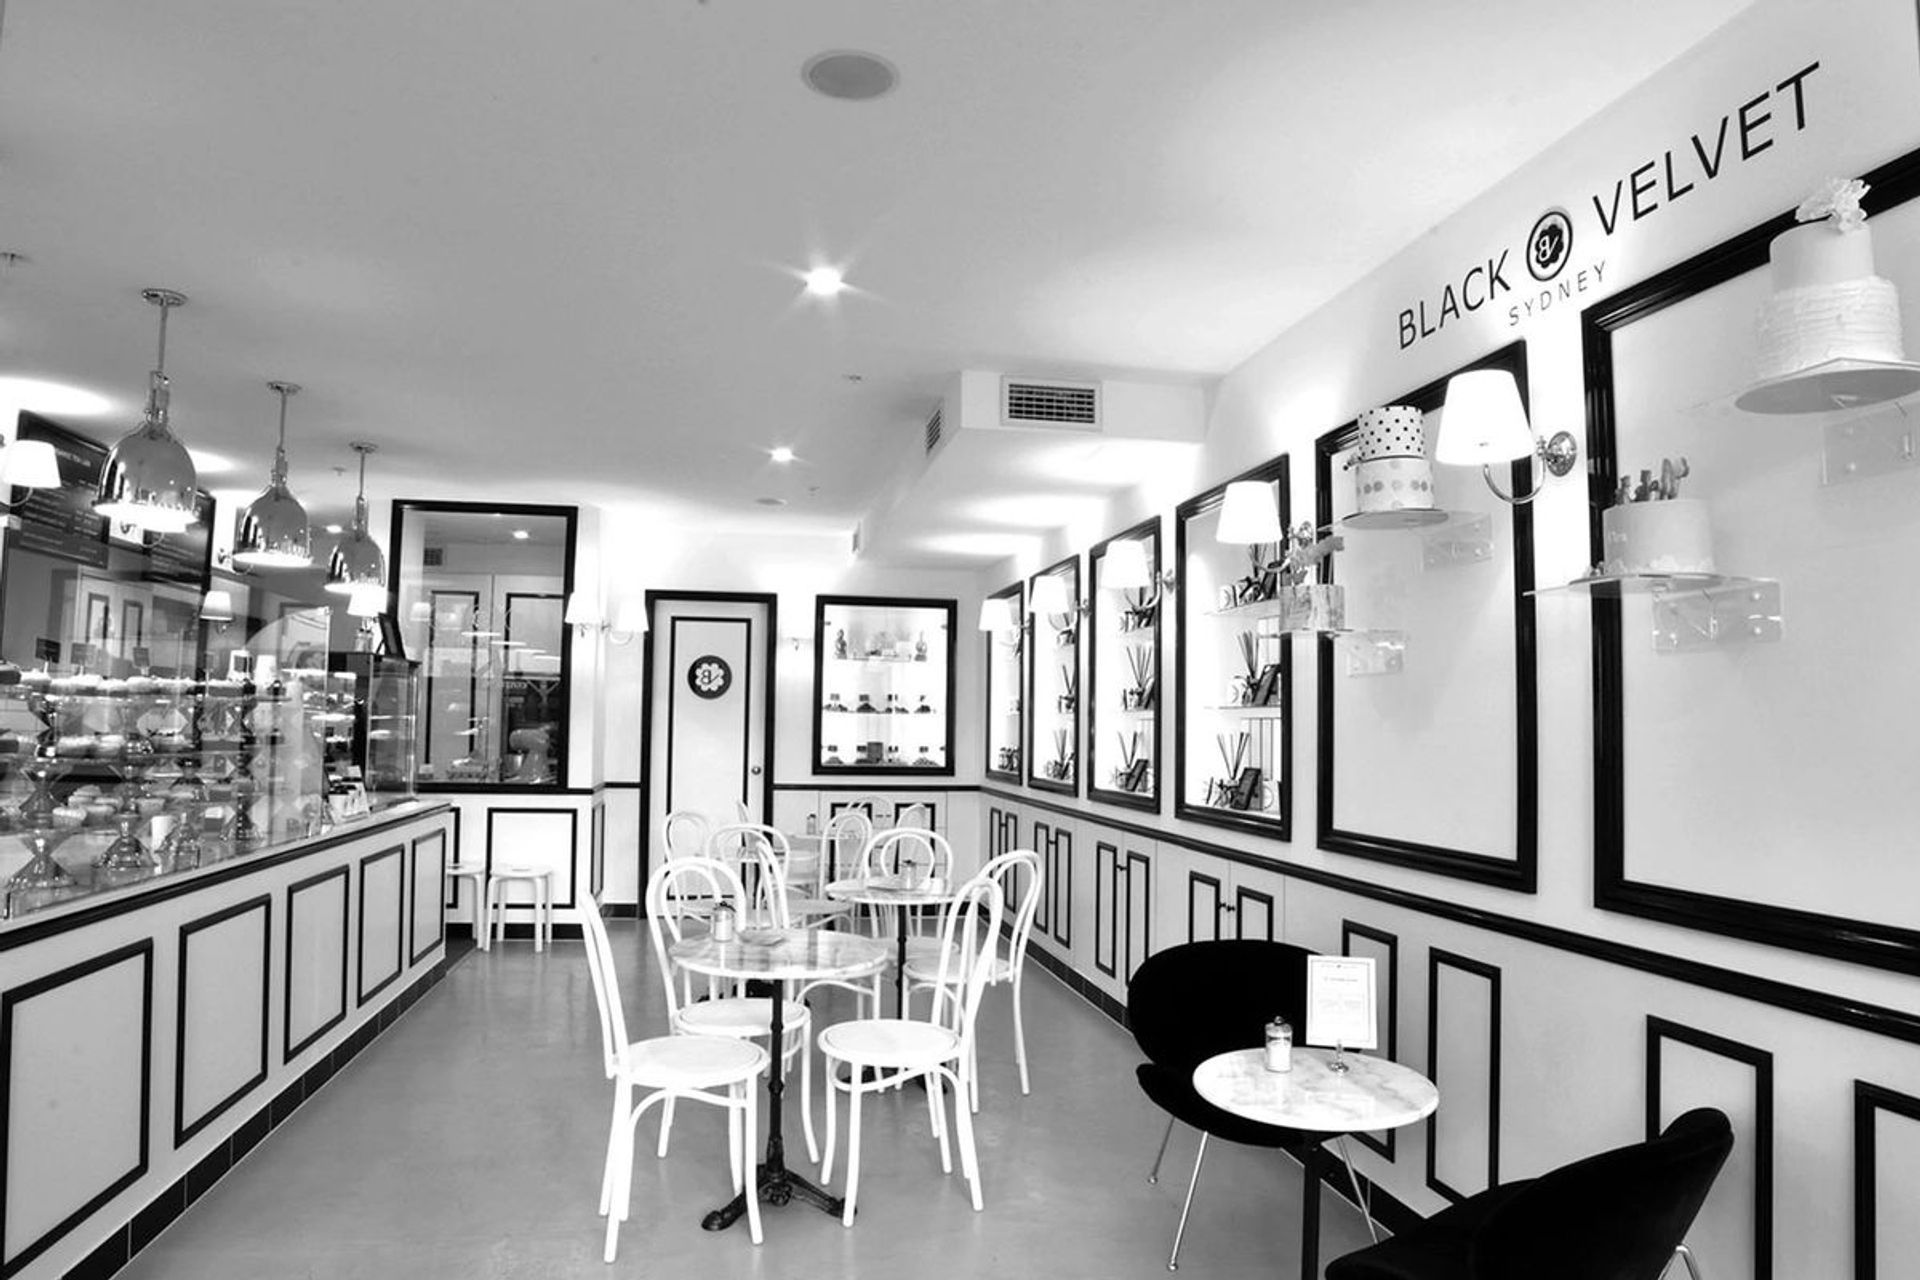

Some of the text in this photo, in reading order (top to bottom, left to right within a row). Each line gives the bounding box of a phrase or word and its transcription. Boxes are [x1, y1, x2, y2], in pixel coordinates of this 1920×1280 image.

[1399, 60, 1820, 350] BLACK VELVET
[1508, 259, 1606, 327] SYDNEY
